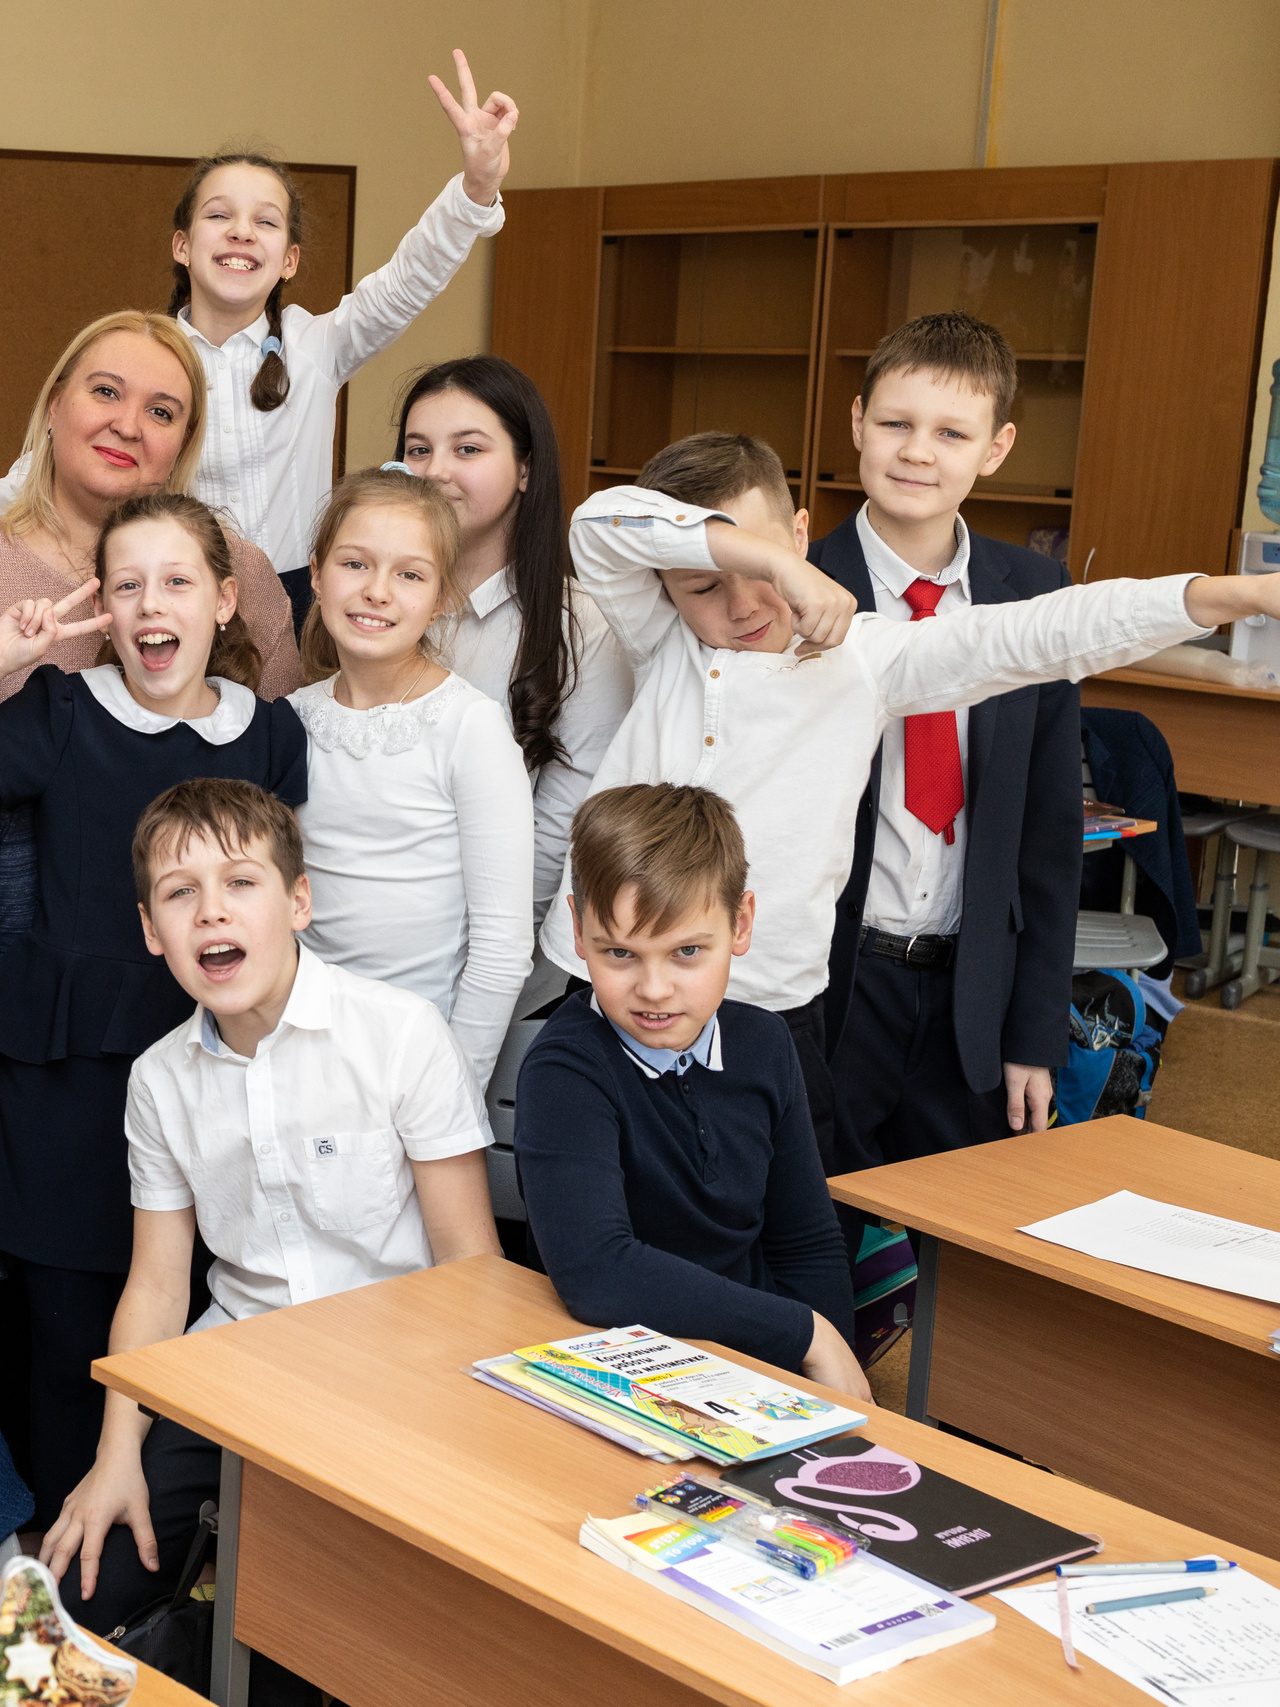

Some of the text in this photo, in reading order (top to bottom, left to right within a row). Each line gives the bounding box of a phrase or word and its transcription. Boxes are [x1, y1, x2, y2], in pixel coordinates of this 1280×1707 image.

[319, 1144, 333, 1154] CS
[592, 1344, 671, 1363] Контрольные
[610, 1357, 655, 1371] работы
[642, 1354, 709, 1372] математике
[527, 1351, 629, 1398] Математика
[704, 1400, 740, 1416] 4
[648, 1529, 681, 1550] STEPS
[665, 1545, 682, 1558] TO
